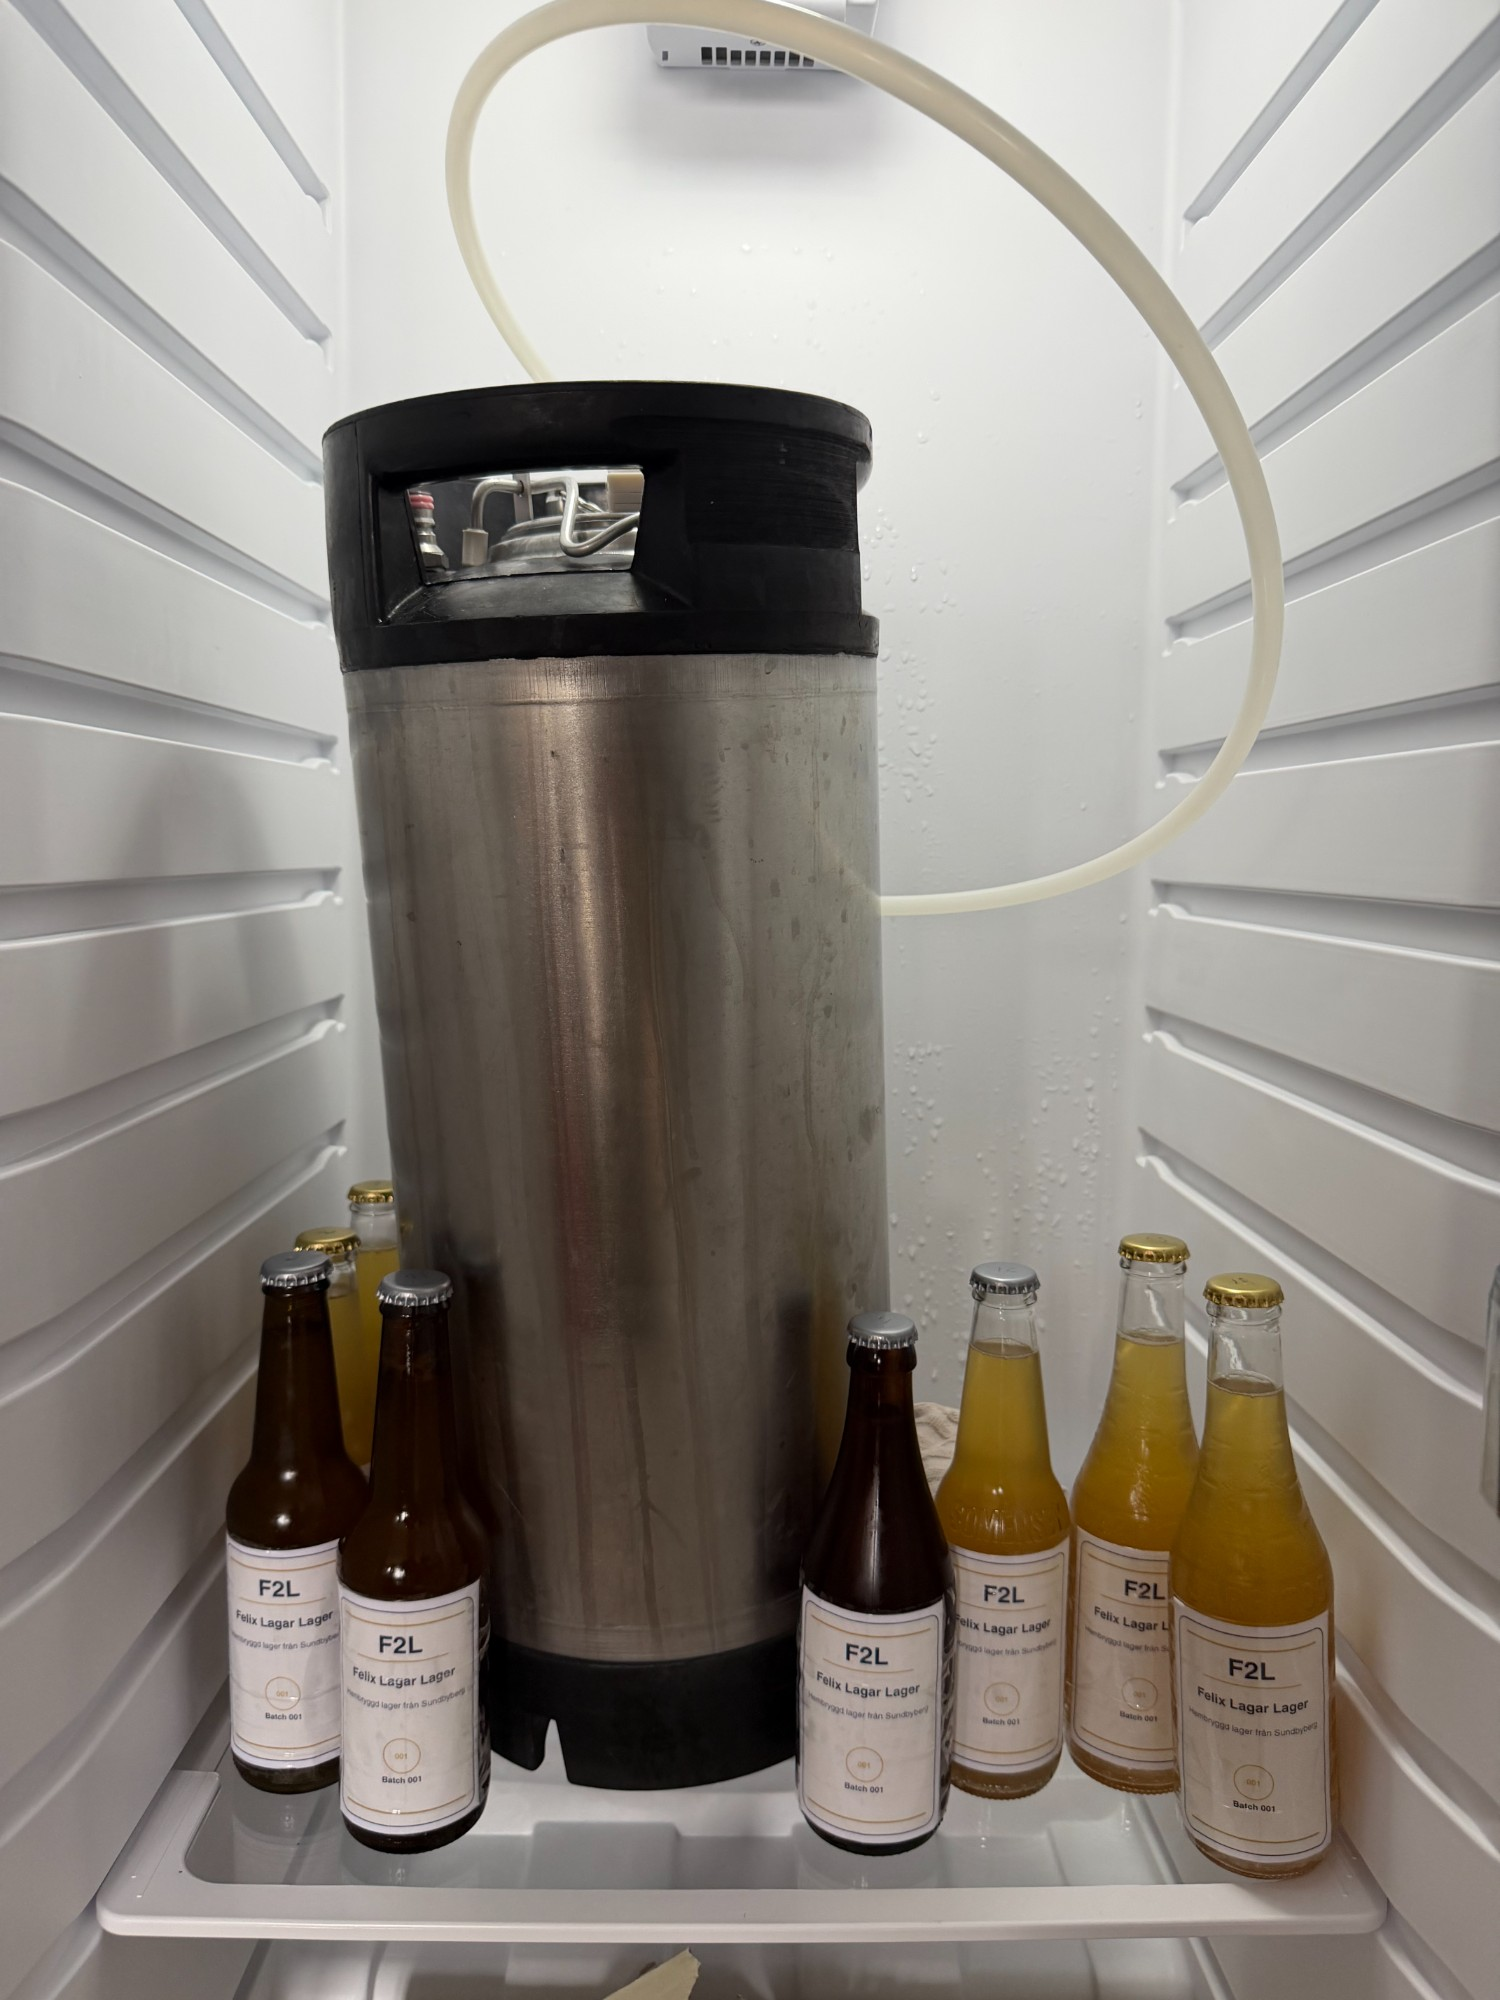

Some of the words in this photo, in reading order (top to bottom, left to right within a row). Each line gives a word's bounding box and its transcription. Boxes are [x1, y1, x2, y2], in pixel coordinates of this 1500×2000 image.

[259, 1579, 300, 1597] F2L
[984, 1584, 1025, 1603] F2L
[1124, 1579, 1166, 1600] F2L
[236, 1609, 257, 1625] Felix
[260, 1616, 295, 1630] Lagar
[299, 1610, 334, 1627] Lager
[956, 1614, 979, 1631] Felix
[983, 1622, 1018, 1636] Lagar
[1022, 1618, 1051, 1633] Lager
[1094, 1606, 1120, 1624] Felix
[1123, 1617, 1158, 1632] Lagar
[379, 1635, 423, 1654] F2L
[845, 1643, 889, 1665] F2L
[353, 1666, 376, 1684] Felix
[379, 1675, 417, 1689] Lagar
[421, 1667, 456, 1685] Lager
[1229, 1658, 1276, 1681] F2L
[816, 1671, 842, 1691] Felix
[845, 1682, 881, 1698] Lagar
[885, 1683, 920, 1698] Lager
[381, 1701, 401, 1711] lager
[403, 1701, 419, 1709] från
[1197, 1686, 1226, 1707] Felix
[1229, 1698, 1269, 1715] Lagar
[1273, 1699, 1309, 1714] Lager
[265, 1712, 287, 1720] Batch
[288, 1713, 302, 1721] 001
[845, 1709, 866, 1720] lager
[867, 1711, 883, 1720] från
[983, 1717, 1005, 1726] Batch
[1007, 1718, 1020, 1726] 001
[1120, 1710, 1143, 1721] Batch
[1144, 1714, 1158, 1722] 001
[1188, 1706, 1230, 1731] Hembryggd
[1231, 1724, 1253, 1736] lager
[1255, 1726, 1272, 1737] från
[1274, 1720, 1318, 1737] Sundbyberg
[394, 1752, 408, 1760] 001
[382, 1775, 406, 1784] Batch
[407, 1775, 422, 1783] 001
[844, 1781, 868, 1793] Batch
[869, 1785, 884, 1793] 001
[1246, 1778, 1261, 1786] 001
[1232, 1800, 1258, 1811] Batch
[1260, 1804, 1276, 1812] 001
